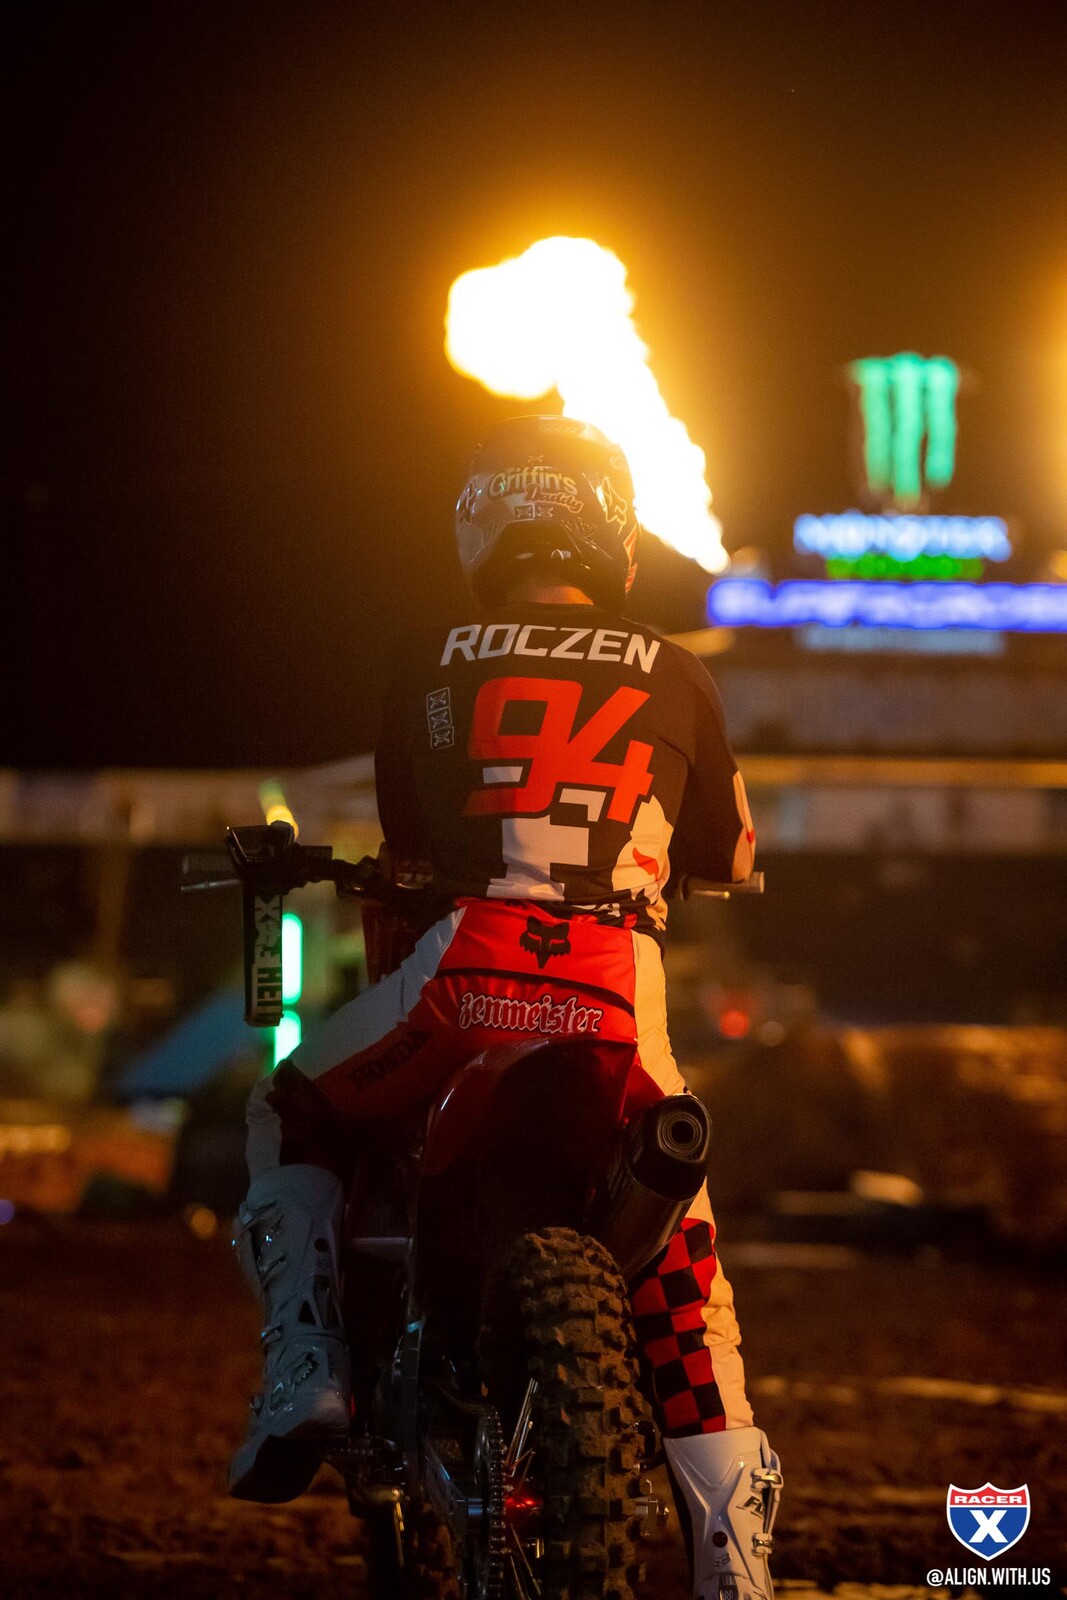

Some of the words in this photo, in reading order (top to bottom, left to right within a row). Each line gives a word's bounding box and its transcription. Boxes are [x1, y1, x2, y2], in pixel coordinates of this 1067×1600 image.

[489, 465, 578, 498] Griffin's
[439, 623, 661, 674] ROCZEN
[463, 676, 655, 824] 94
[458, 991, 605, 1034] zenmeister
[346, 1030, 432, 1089] HONDA
